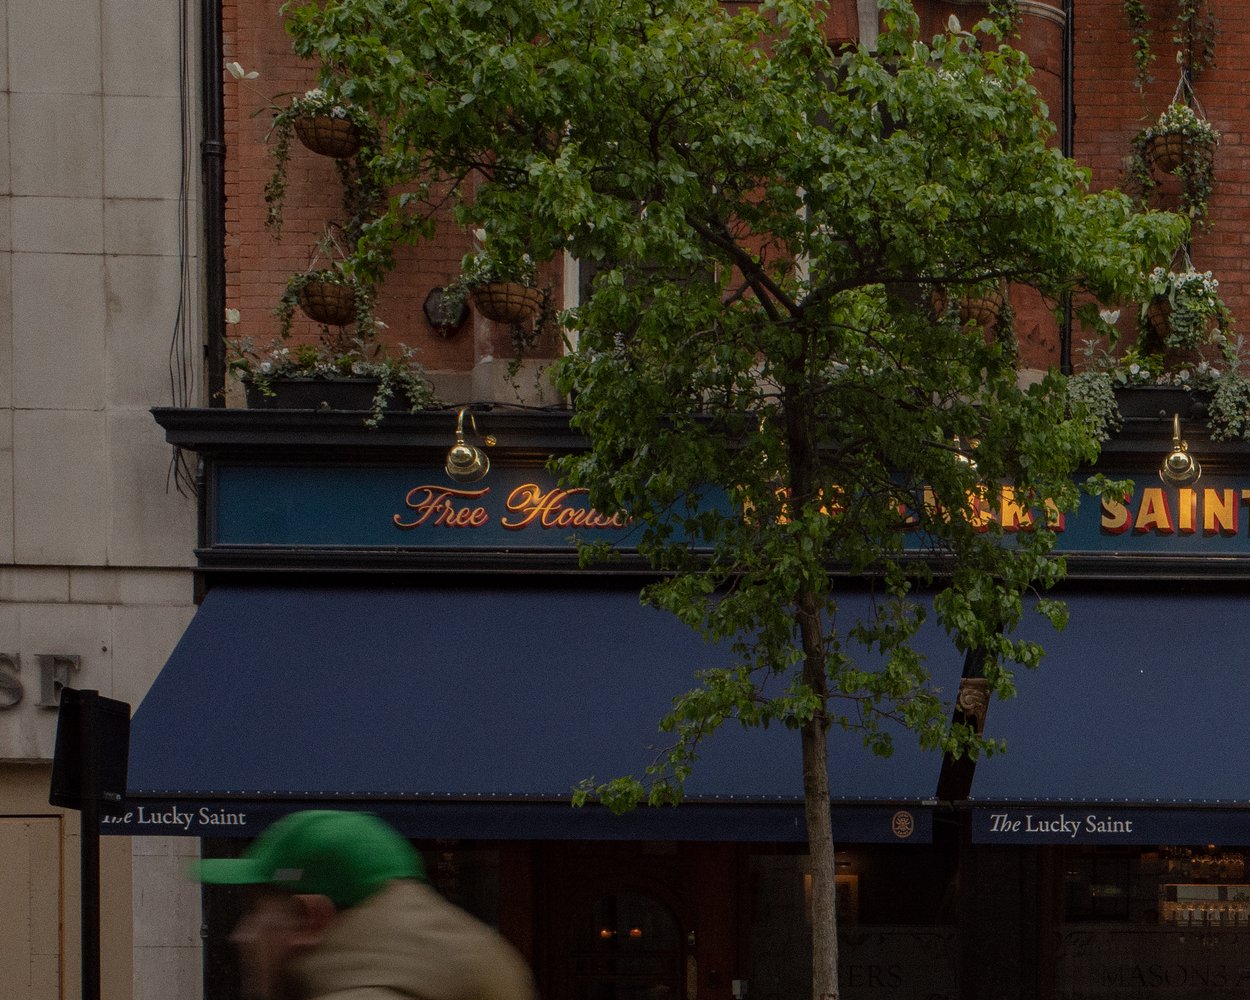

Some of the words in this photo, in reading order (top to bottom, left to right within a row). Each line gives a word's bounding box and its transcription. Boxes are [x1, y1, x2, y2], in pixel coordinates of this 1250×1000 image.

[393, 483, 490, 530] Free
[137, 806, 195, 831] Lucky
[198, 807, 247, 826] Saint
[989, 814, 1022, 834] The
[1024, 814, 1082, 841] Lucky
[1085, 815, 1133, 835] Saint
